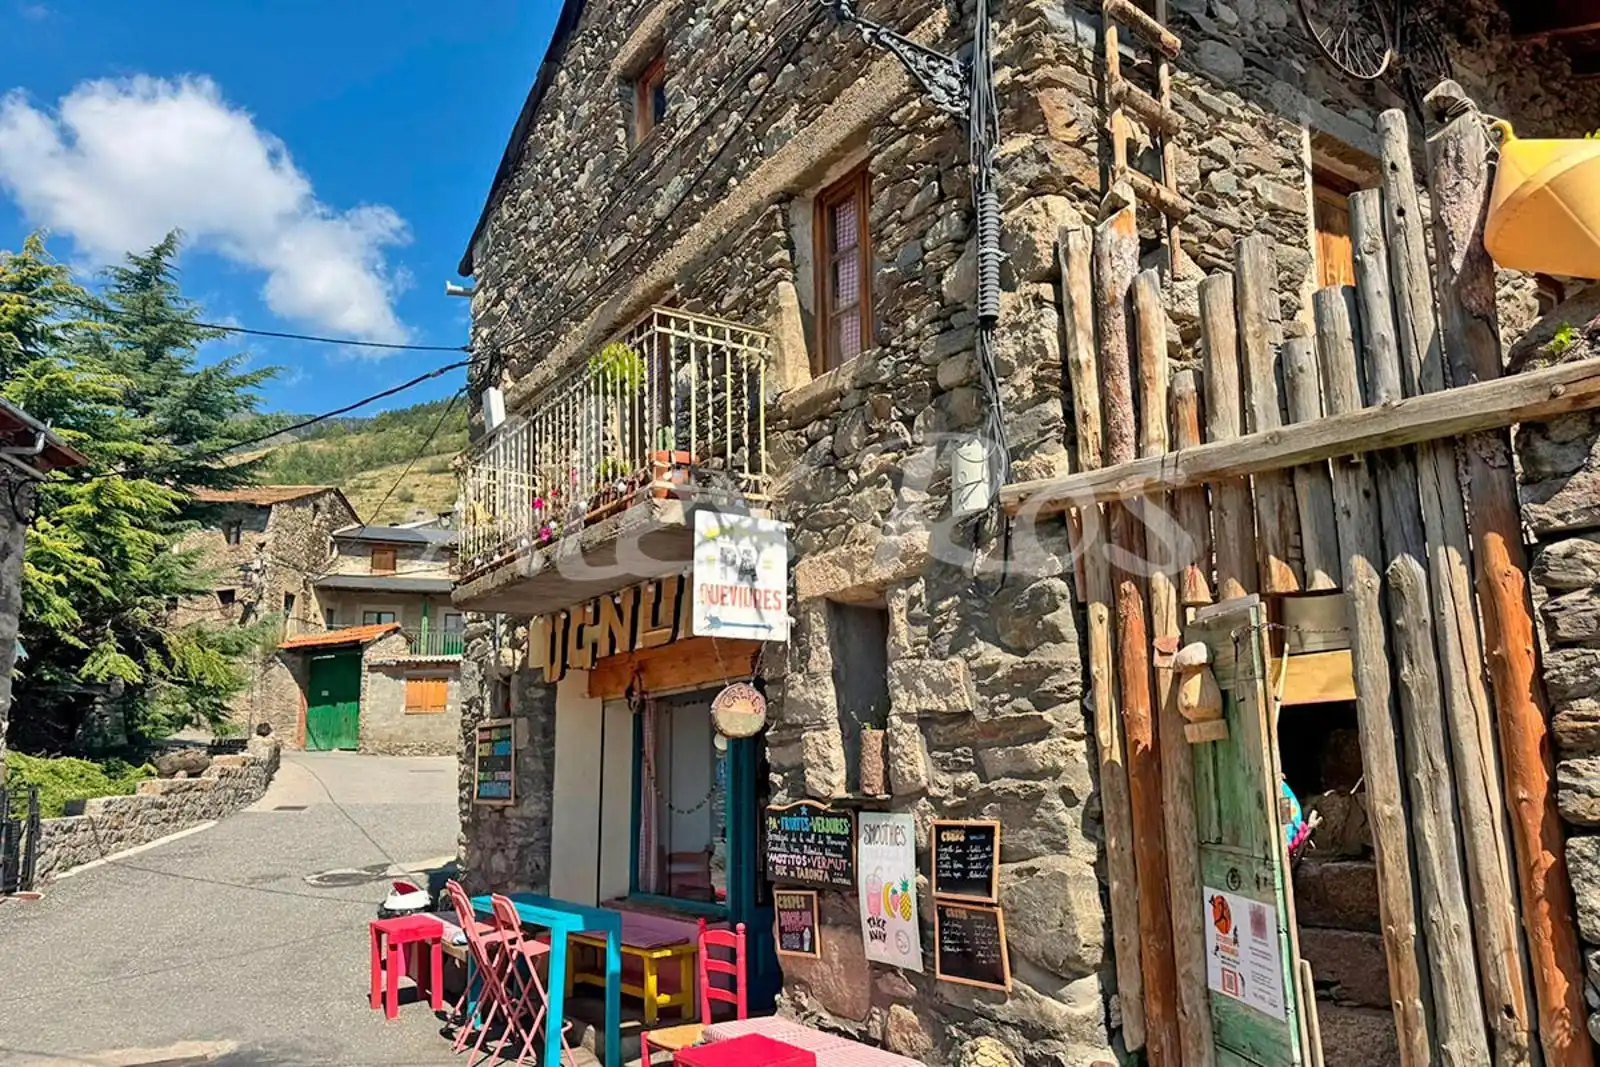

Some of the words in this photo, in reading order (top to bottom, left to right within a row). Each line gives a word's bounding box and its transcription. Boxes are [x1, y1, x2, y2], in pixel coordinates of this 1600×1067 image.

[812, 816, 849, 835] VERDURES
[811, 856, 847, 871] VERMUT
[867, 915, 886, 931] TAKE
[869, 930, 887, 943] AWAY
